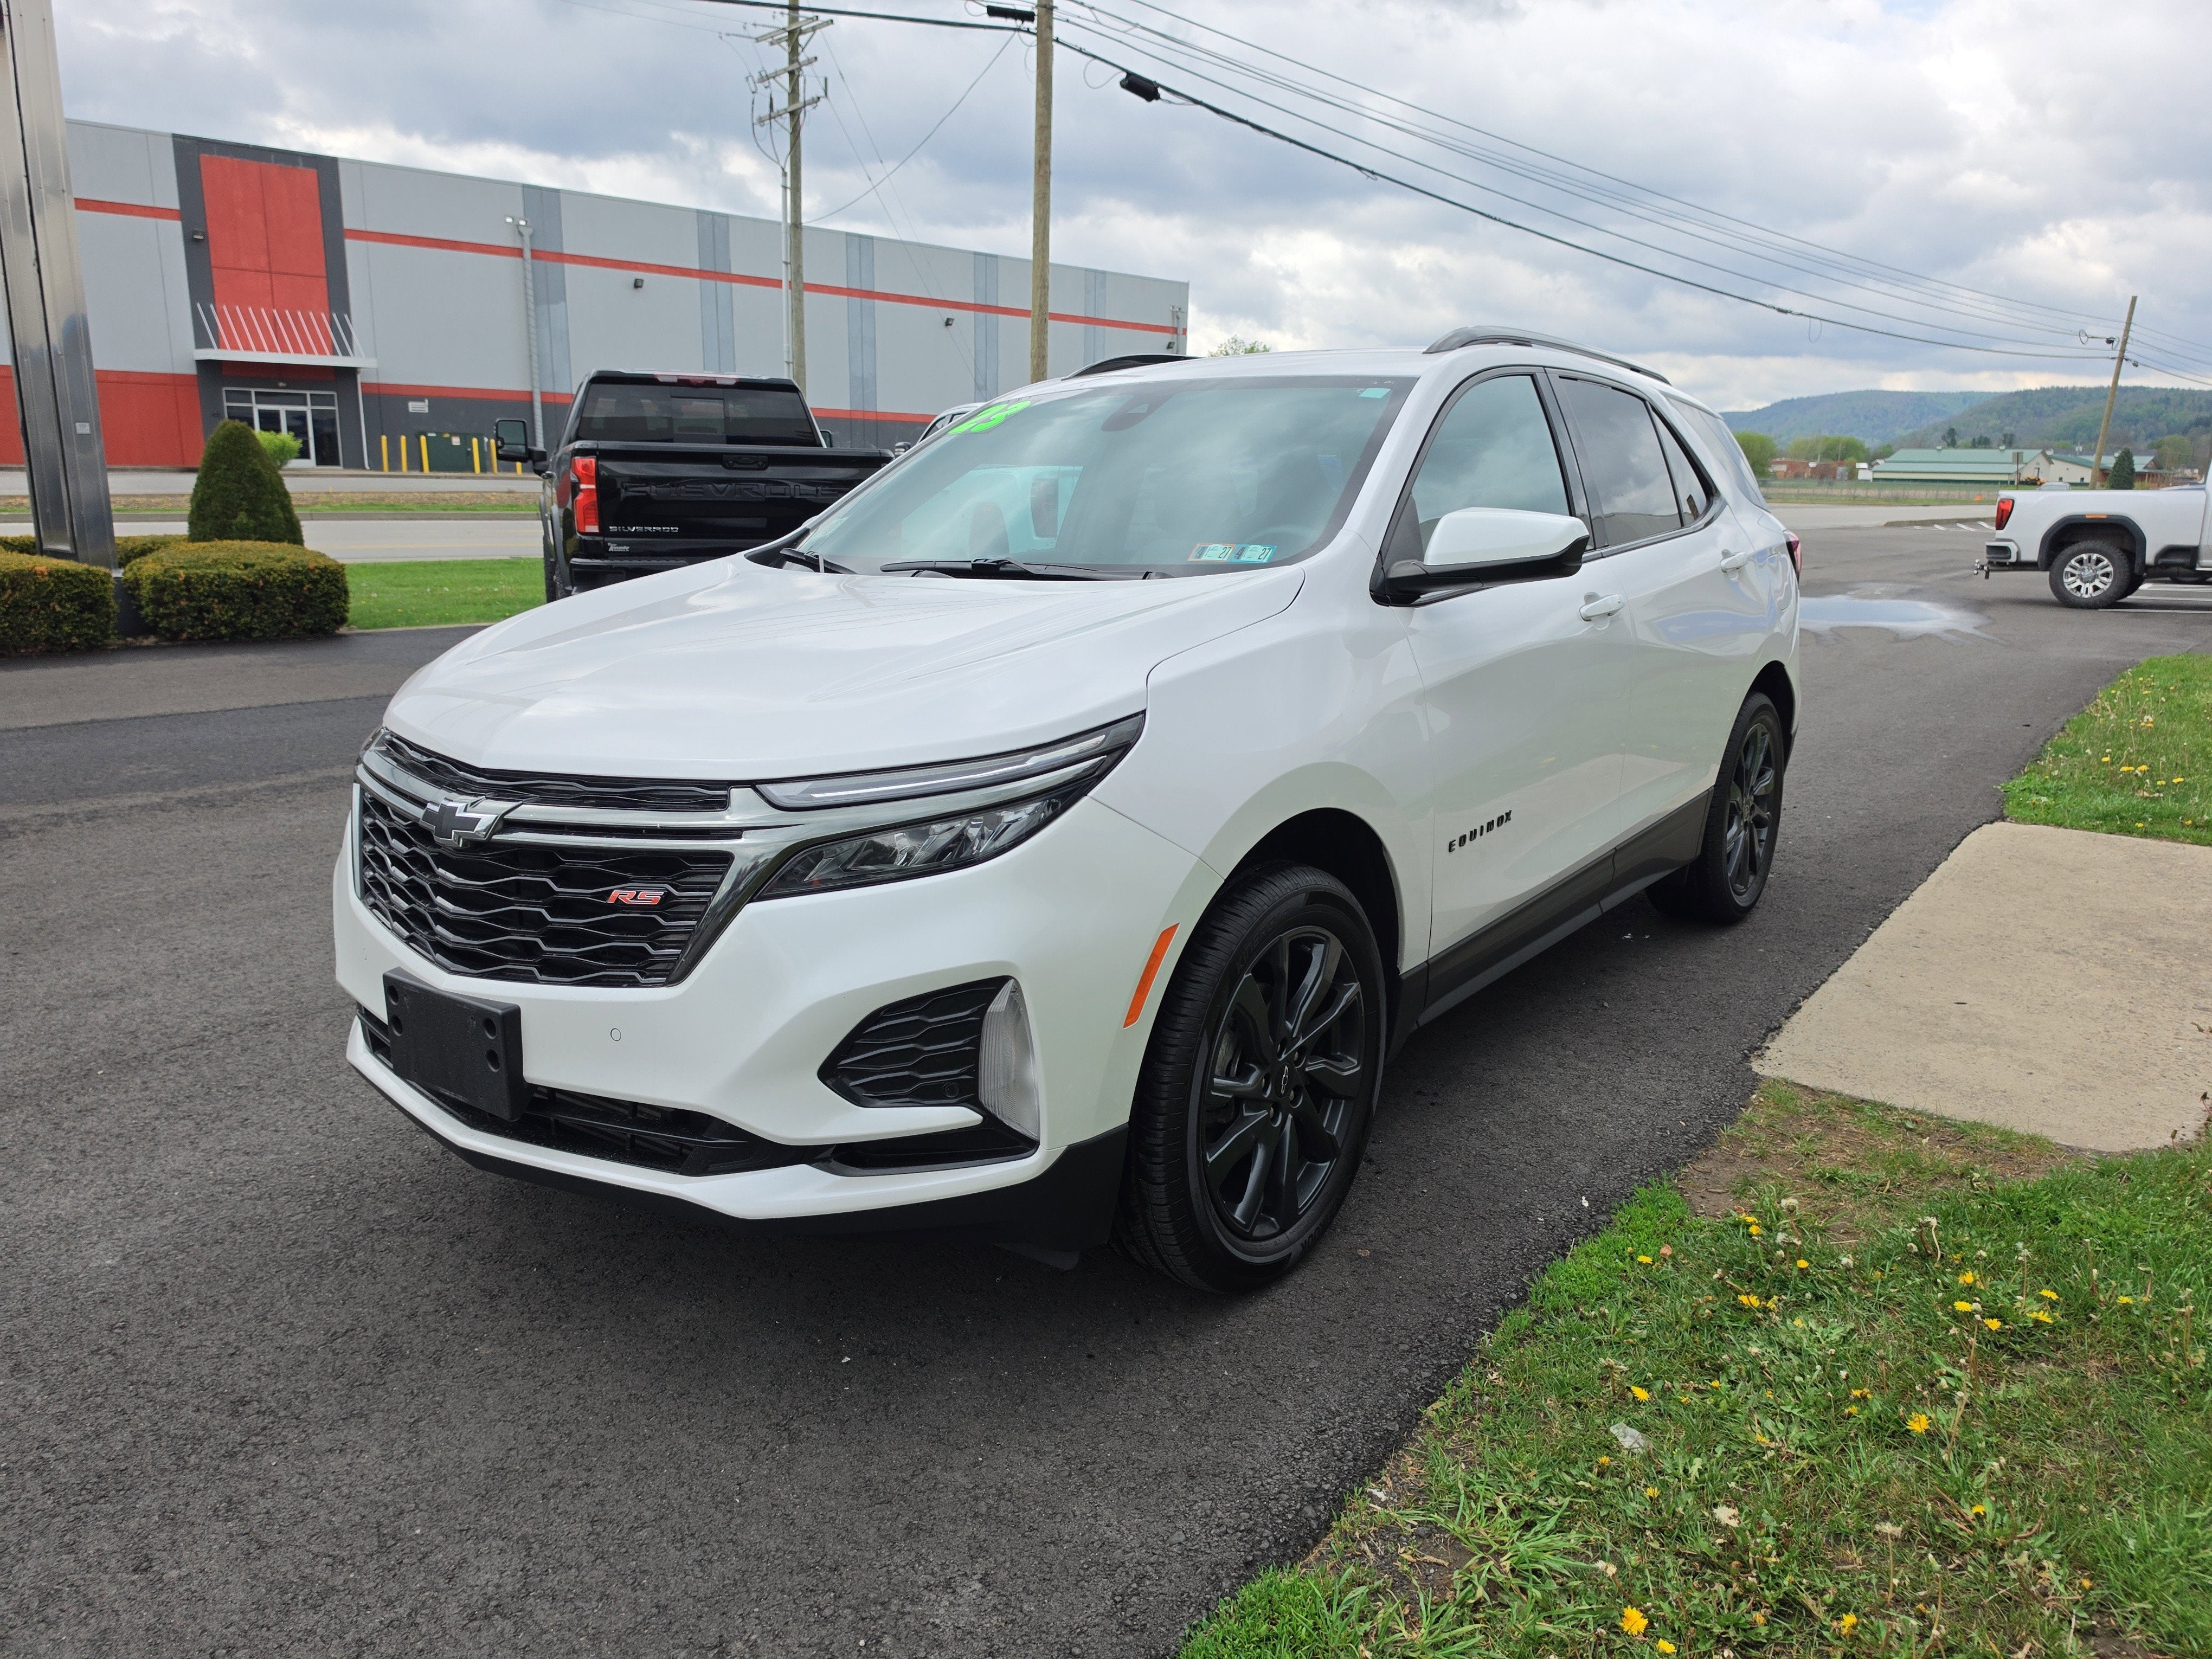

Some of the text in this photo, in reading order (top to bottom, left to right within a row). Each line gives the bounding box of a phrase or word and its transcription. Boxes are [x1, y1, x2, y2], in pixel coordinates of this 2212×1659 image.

[947, 400, 1032, 435] 23
[620, 483, 849, 500] CHEVROLE
[1218, 546, 1232, 560] 27
[1234, 546, 1272, 560] 4 27
[1448, 810, 1512, 852] EQUINOX
[607, 890, 664, 905] RS
